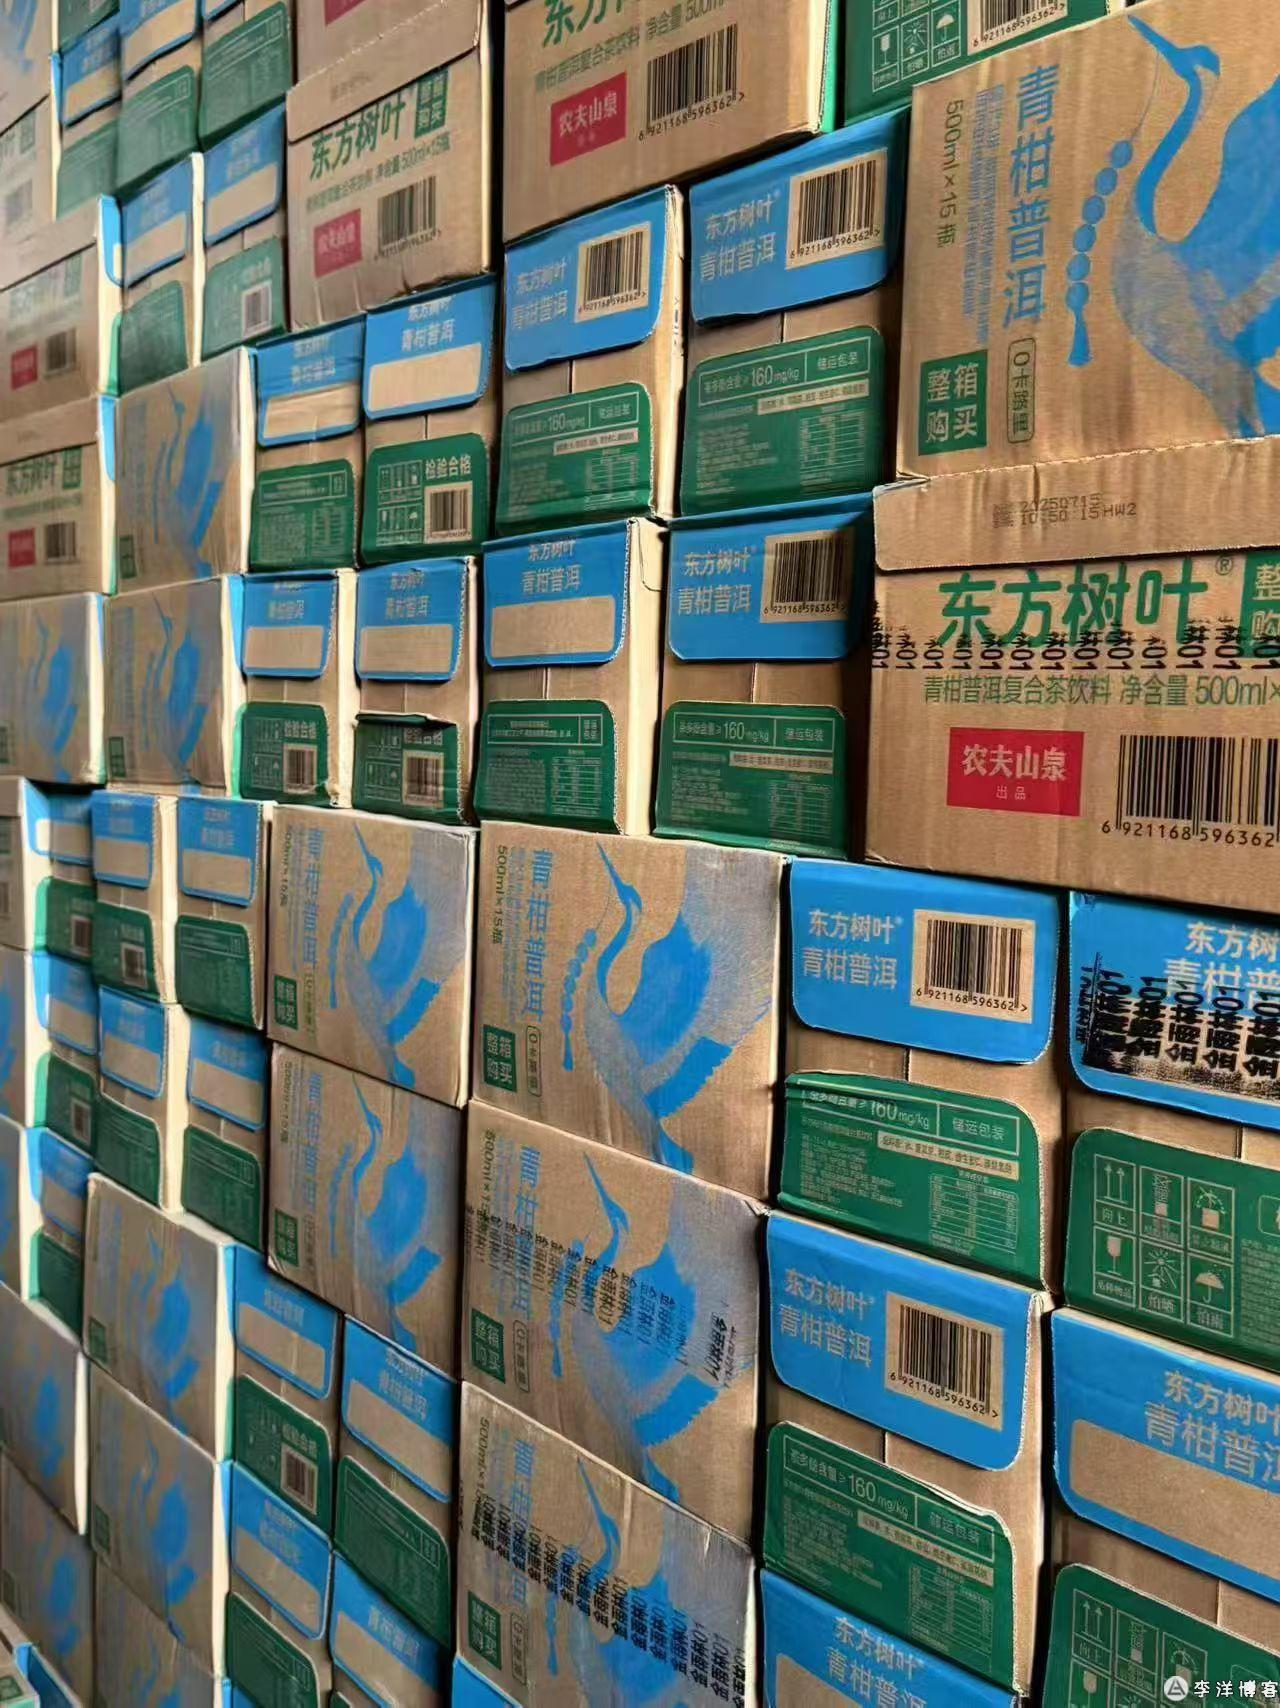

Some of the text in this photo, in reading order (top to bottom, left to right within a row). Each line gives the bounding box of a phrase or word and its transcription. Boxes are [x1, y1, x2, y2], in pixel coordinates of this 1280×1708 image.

[558, 91, 618, 138] 农夫山泉
[705, 192, 775, 241] 东方树叶
[1003, 64, 1060, 329] 青柑普洱
[700, 231, 777, 282] 青柑普洱
[926, 362, 979, 403] 整箱
[925, 407, 979, 443] 购买
[522, 563, 583, 595] 青柑普洱
[683, 547, 750, 578] 东方树叶
[678, 583, 752, 616] 青柑普洱
[936, 553, 1209, 649] 东方树叶
[924, 675, 1110, 707] 青柑普洱复合茶饮料
[1120, 676, 1188, 707] 净含量
[962, 745, 1068, 783] 农夫山泉
[808, 908, 896, 945] 东方树叶
[802, 948, 898, 991] 青柑普洱
[783, 1268, 869, 1323] 东方树叶
[778, 1303, 873, 1369] 青柑普洱
[833, 1616, 916, 1681] 东方树叶
